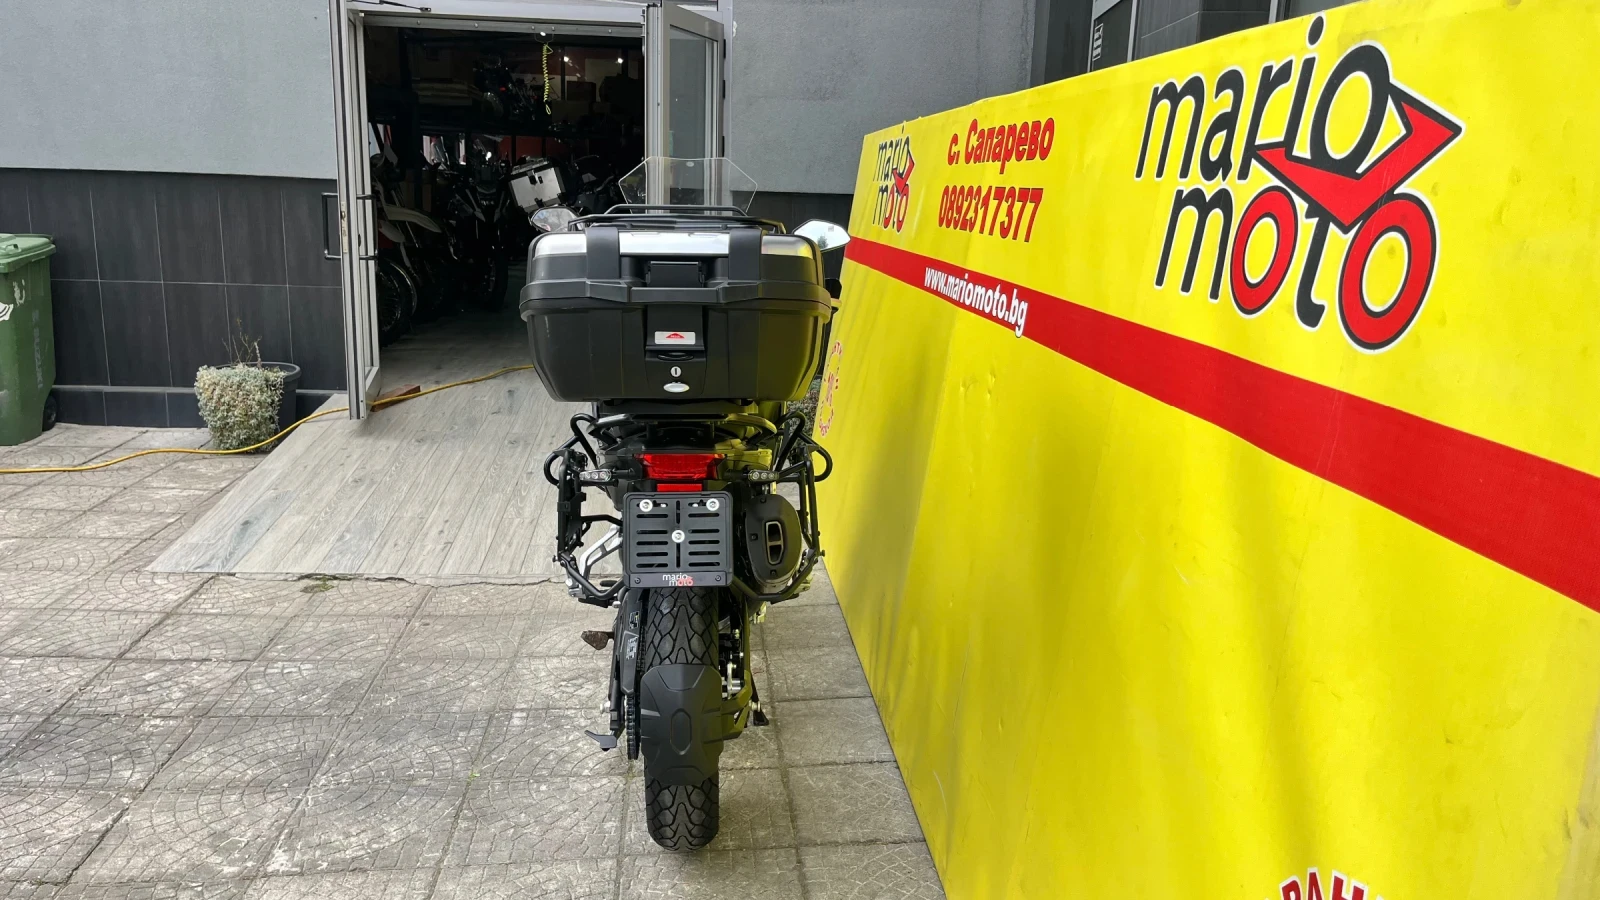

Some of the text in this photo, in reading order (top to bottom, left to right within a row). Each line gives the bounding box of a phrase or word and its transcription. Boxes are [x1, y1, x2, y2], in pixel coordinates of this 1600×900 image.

[1135, 13, 1392, 182] mario
[873, 125, 910, 181] mario
[947, 117, 1055, 174] с. Сапарево
[873, 182, 910, 233] moto
[938, 184, 1044, 242] 0892317377
[1154, 185, 1438, 354] moto
[924, 266, 1028, 338] www.mariomoto.bg
[662, 572, 688, 581] mario
[668, 579, 694, 587] moto
